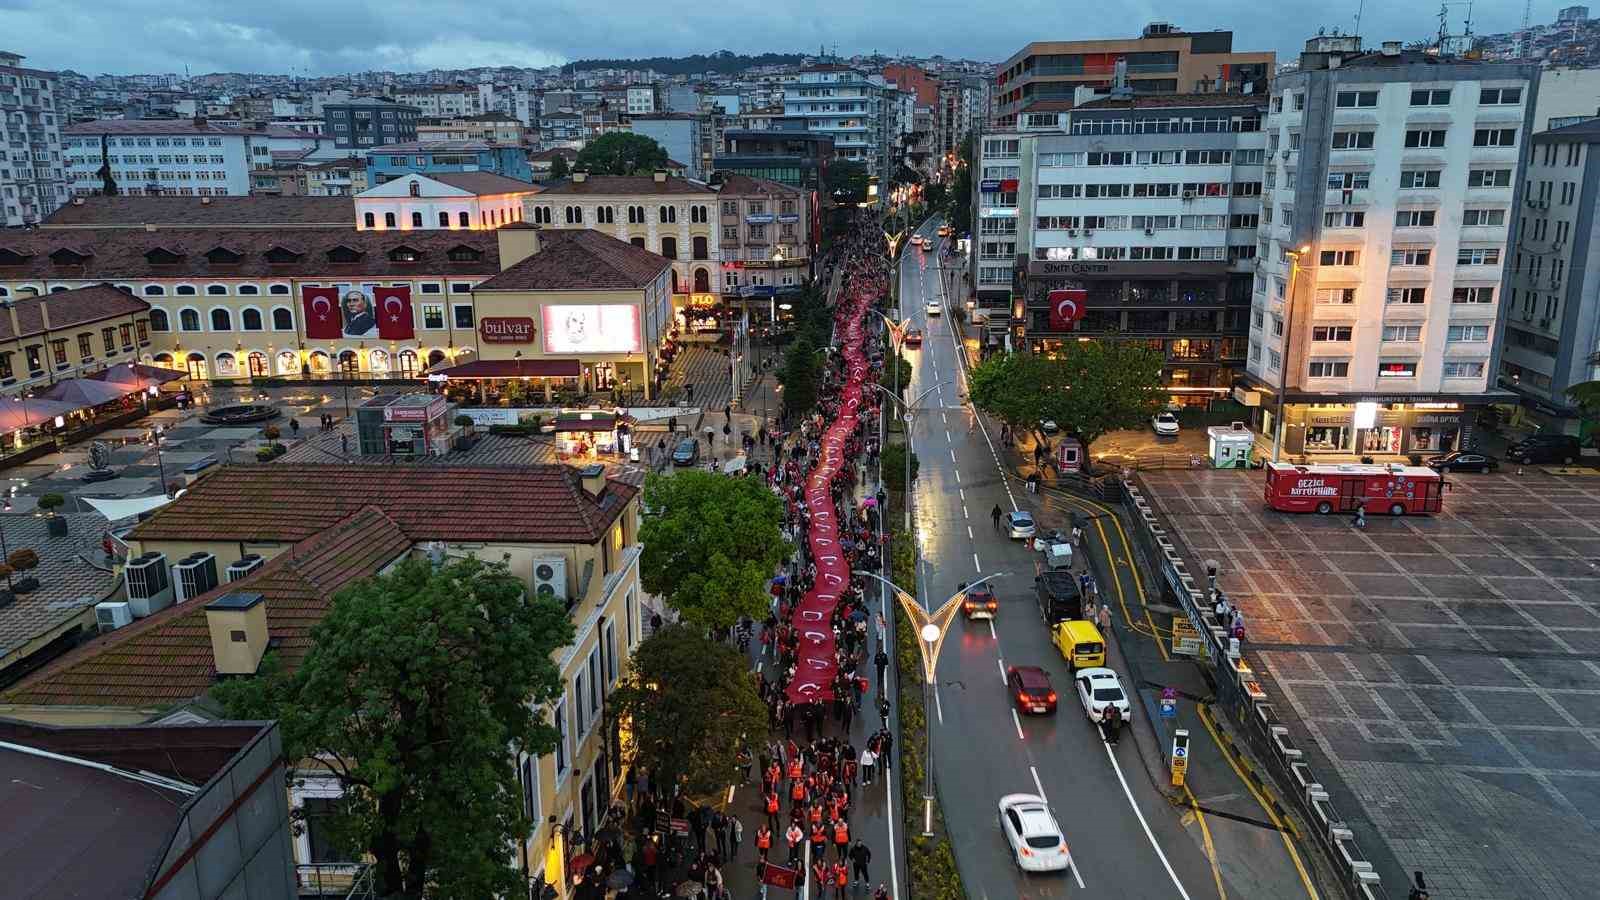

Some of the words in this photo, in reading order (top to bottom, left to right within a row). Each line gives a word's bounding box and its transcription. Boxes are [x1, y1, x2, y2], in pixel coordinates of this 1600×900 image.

[1072, 263, 1108, 274] CENTER
[691, 294, 714, 305] FLO
[485, 320, 530, 334] bulvar
